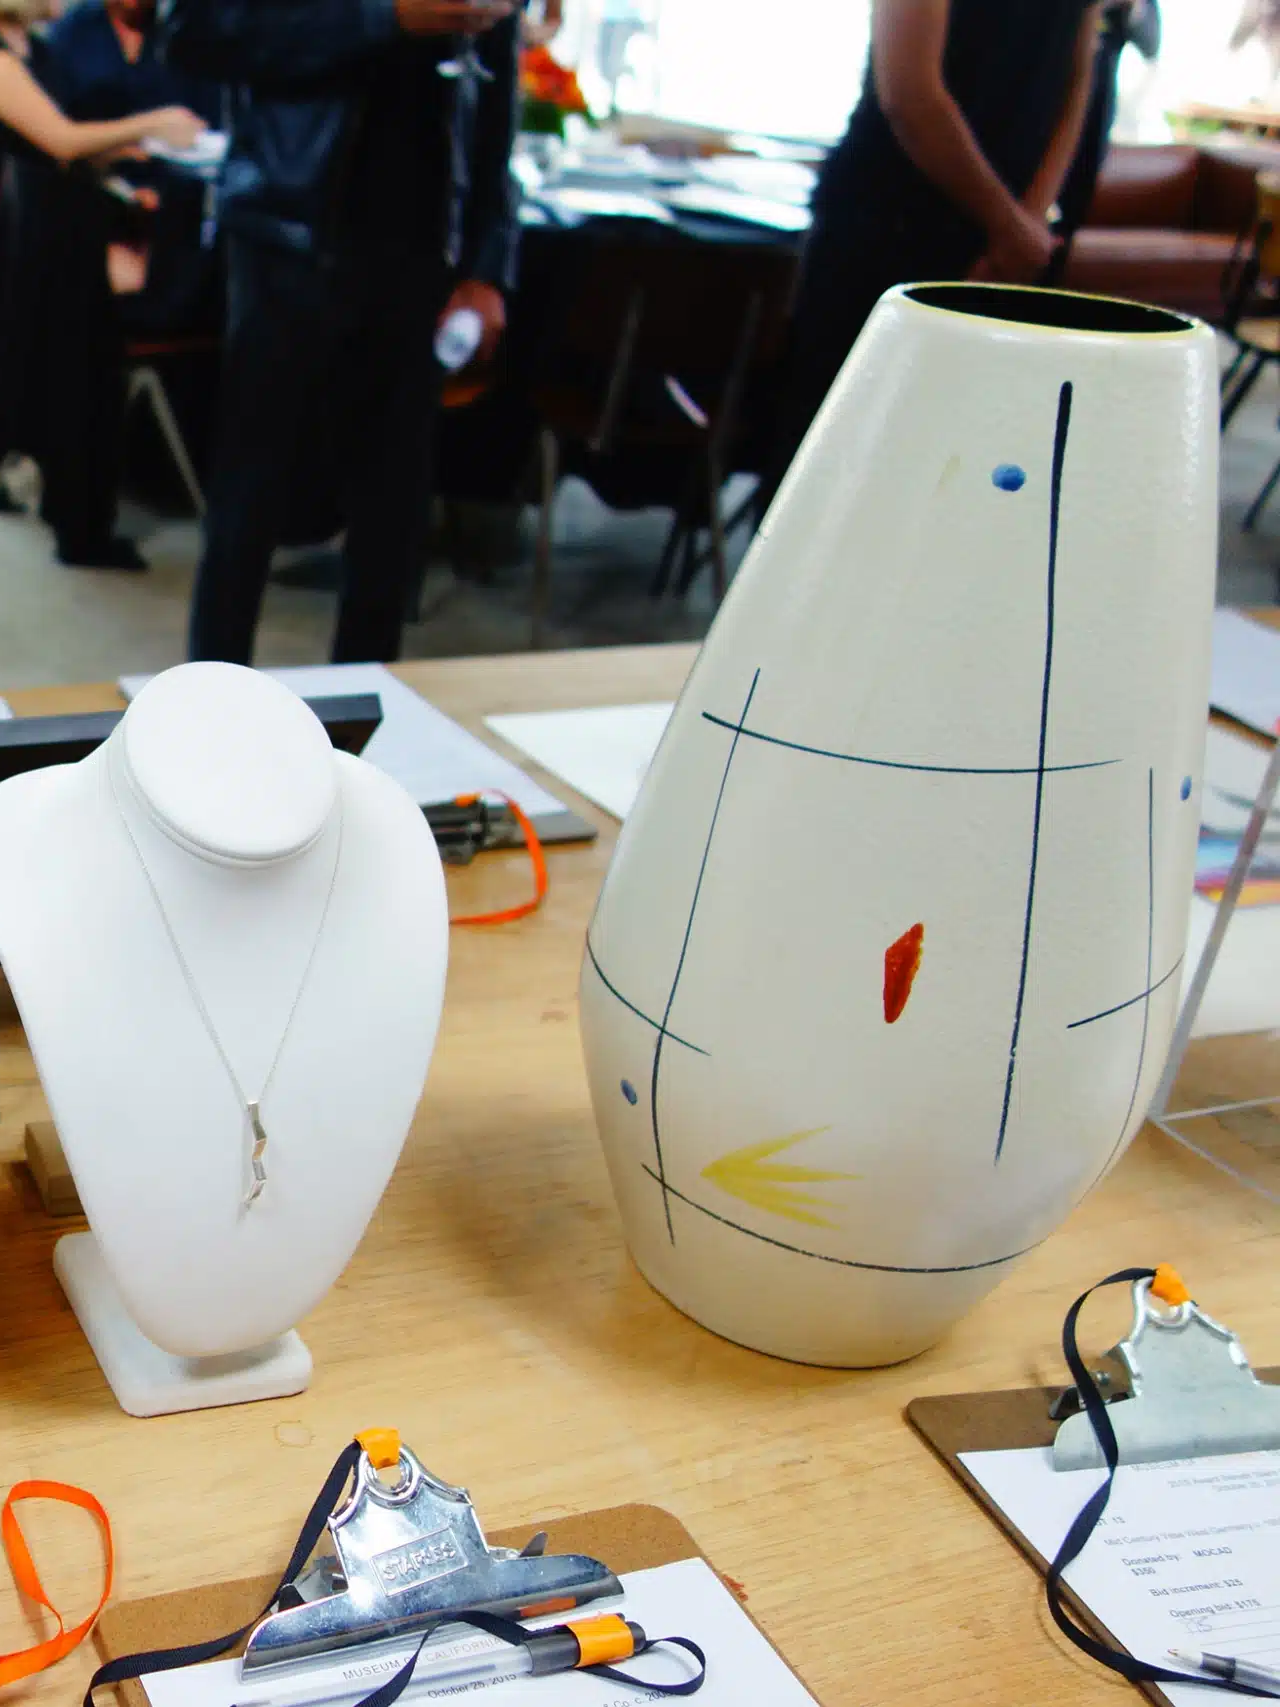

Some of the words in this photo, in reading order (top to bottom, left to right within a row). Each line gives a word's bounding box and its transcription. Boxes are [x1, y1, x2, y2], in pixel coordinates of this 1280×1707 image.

[1121, 1554, 1166, 1566] Donated
[1192, 1546, 1233, 1558] MOCAD
[1148, 1587, 1169, 1597] Bid
[1222, 1578, 1244, 1588] $25
[1169, 1605, 1216, 1619] Opening
[342, 1659, 402, 1681] MUSEUM
[423, 1637, 504, 1662] CALIFORNIA
[427, 1684, 470, 1699] October
